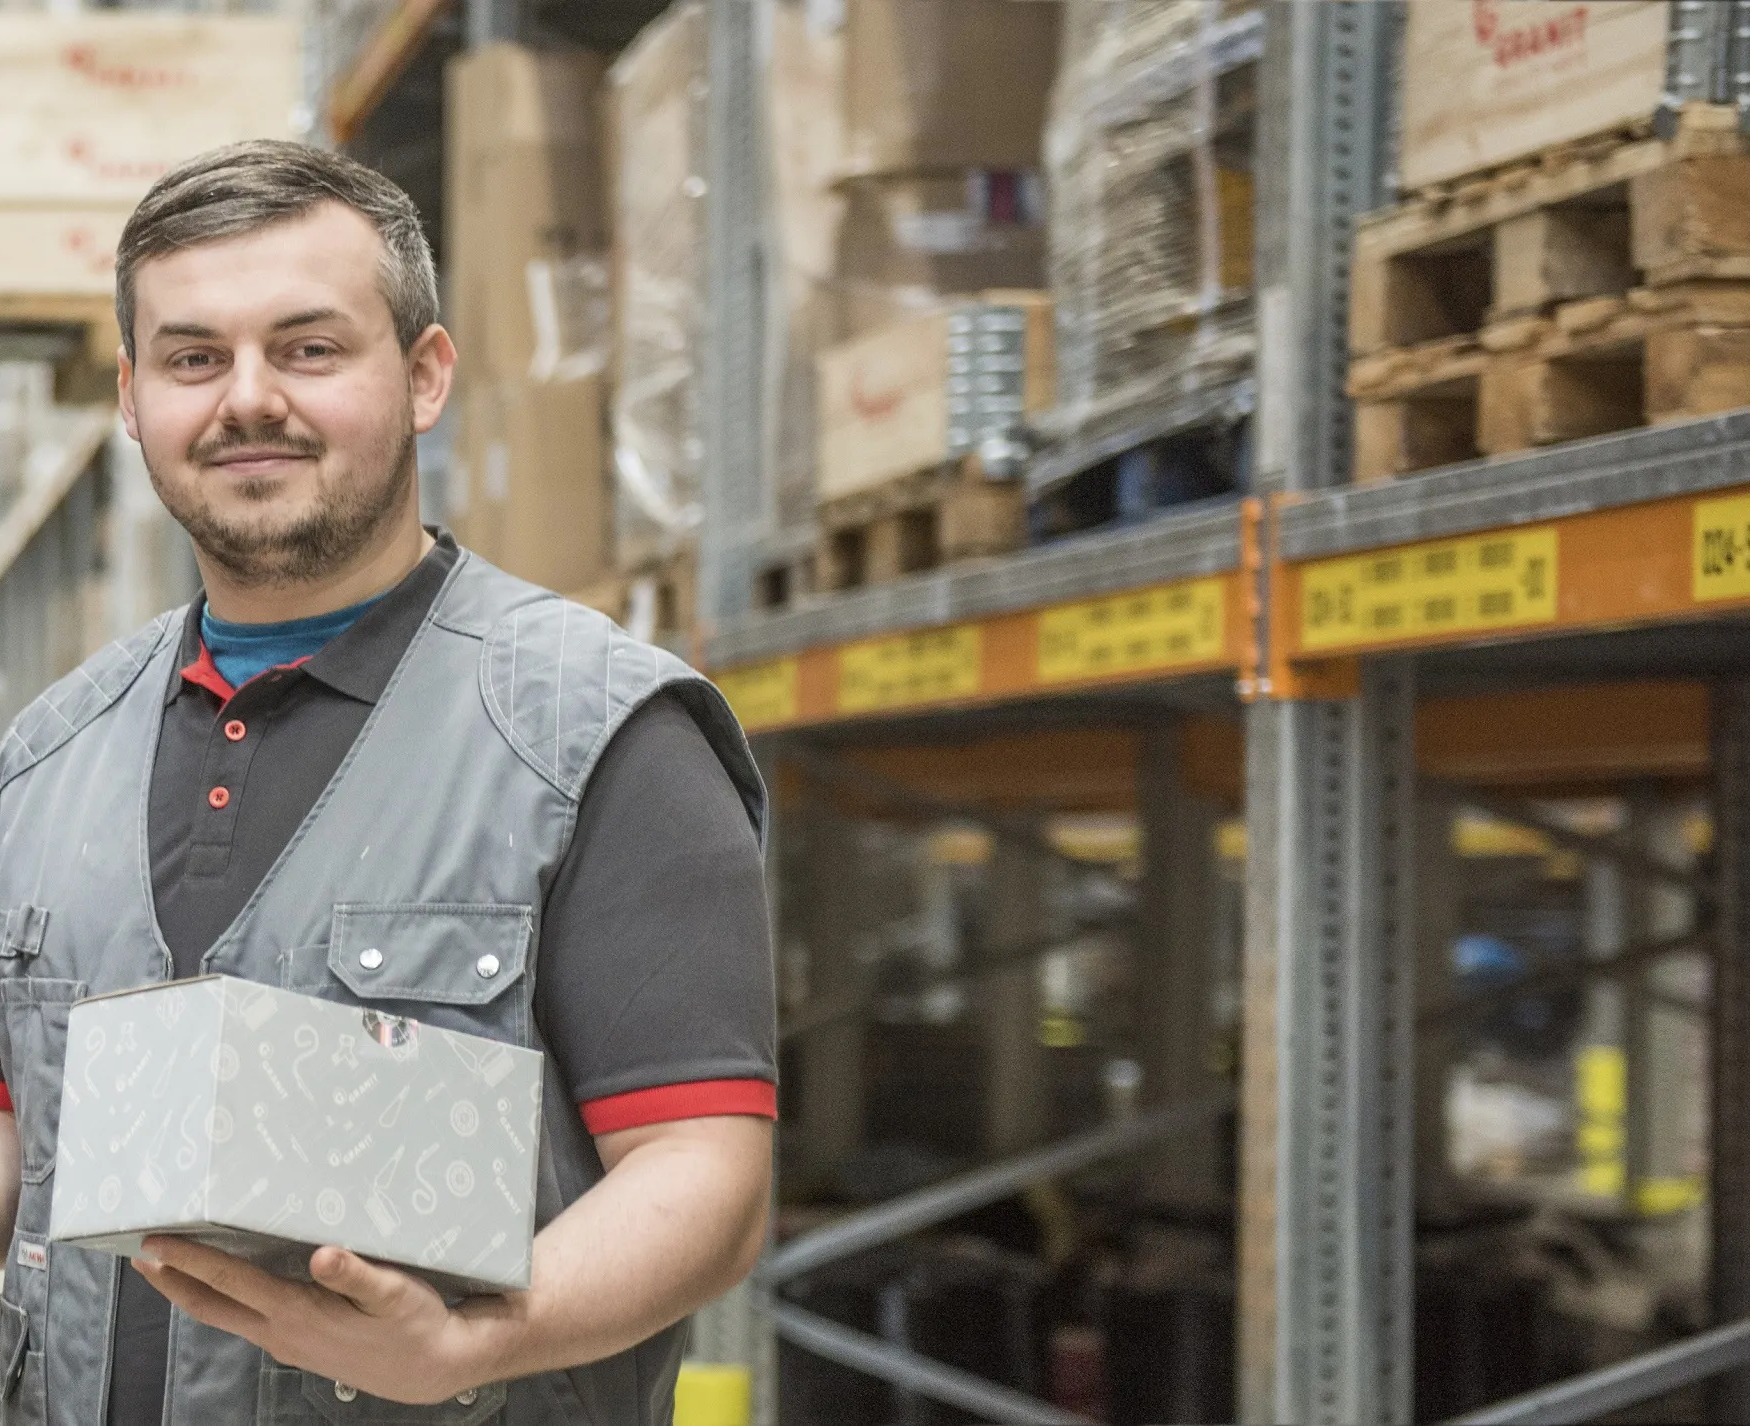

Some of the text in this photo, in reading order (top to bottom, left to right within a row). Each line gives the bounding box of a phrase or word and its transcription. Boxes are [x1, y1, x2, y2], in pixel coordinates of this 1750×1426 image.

[262, 1060, 288, 1100] GRANIT
[349, 1073, 378, 1102] GRANIT
[256, 1122, 284, 1161] GRANIT
[343, 1132, 373, 1164] GRANIT
[499, 1115, 526, 1154] GRANIT
[494, 1176, 522, 1214] GRANIT
